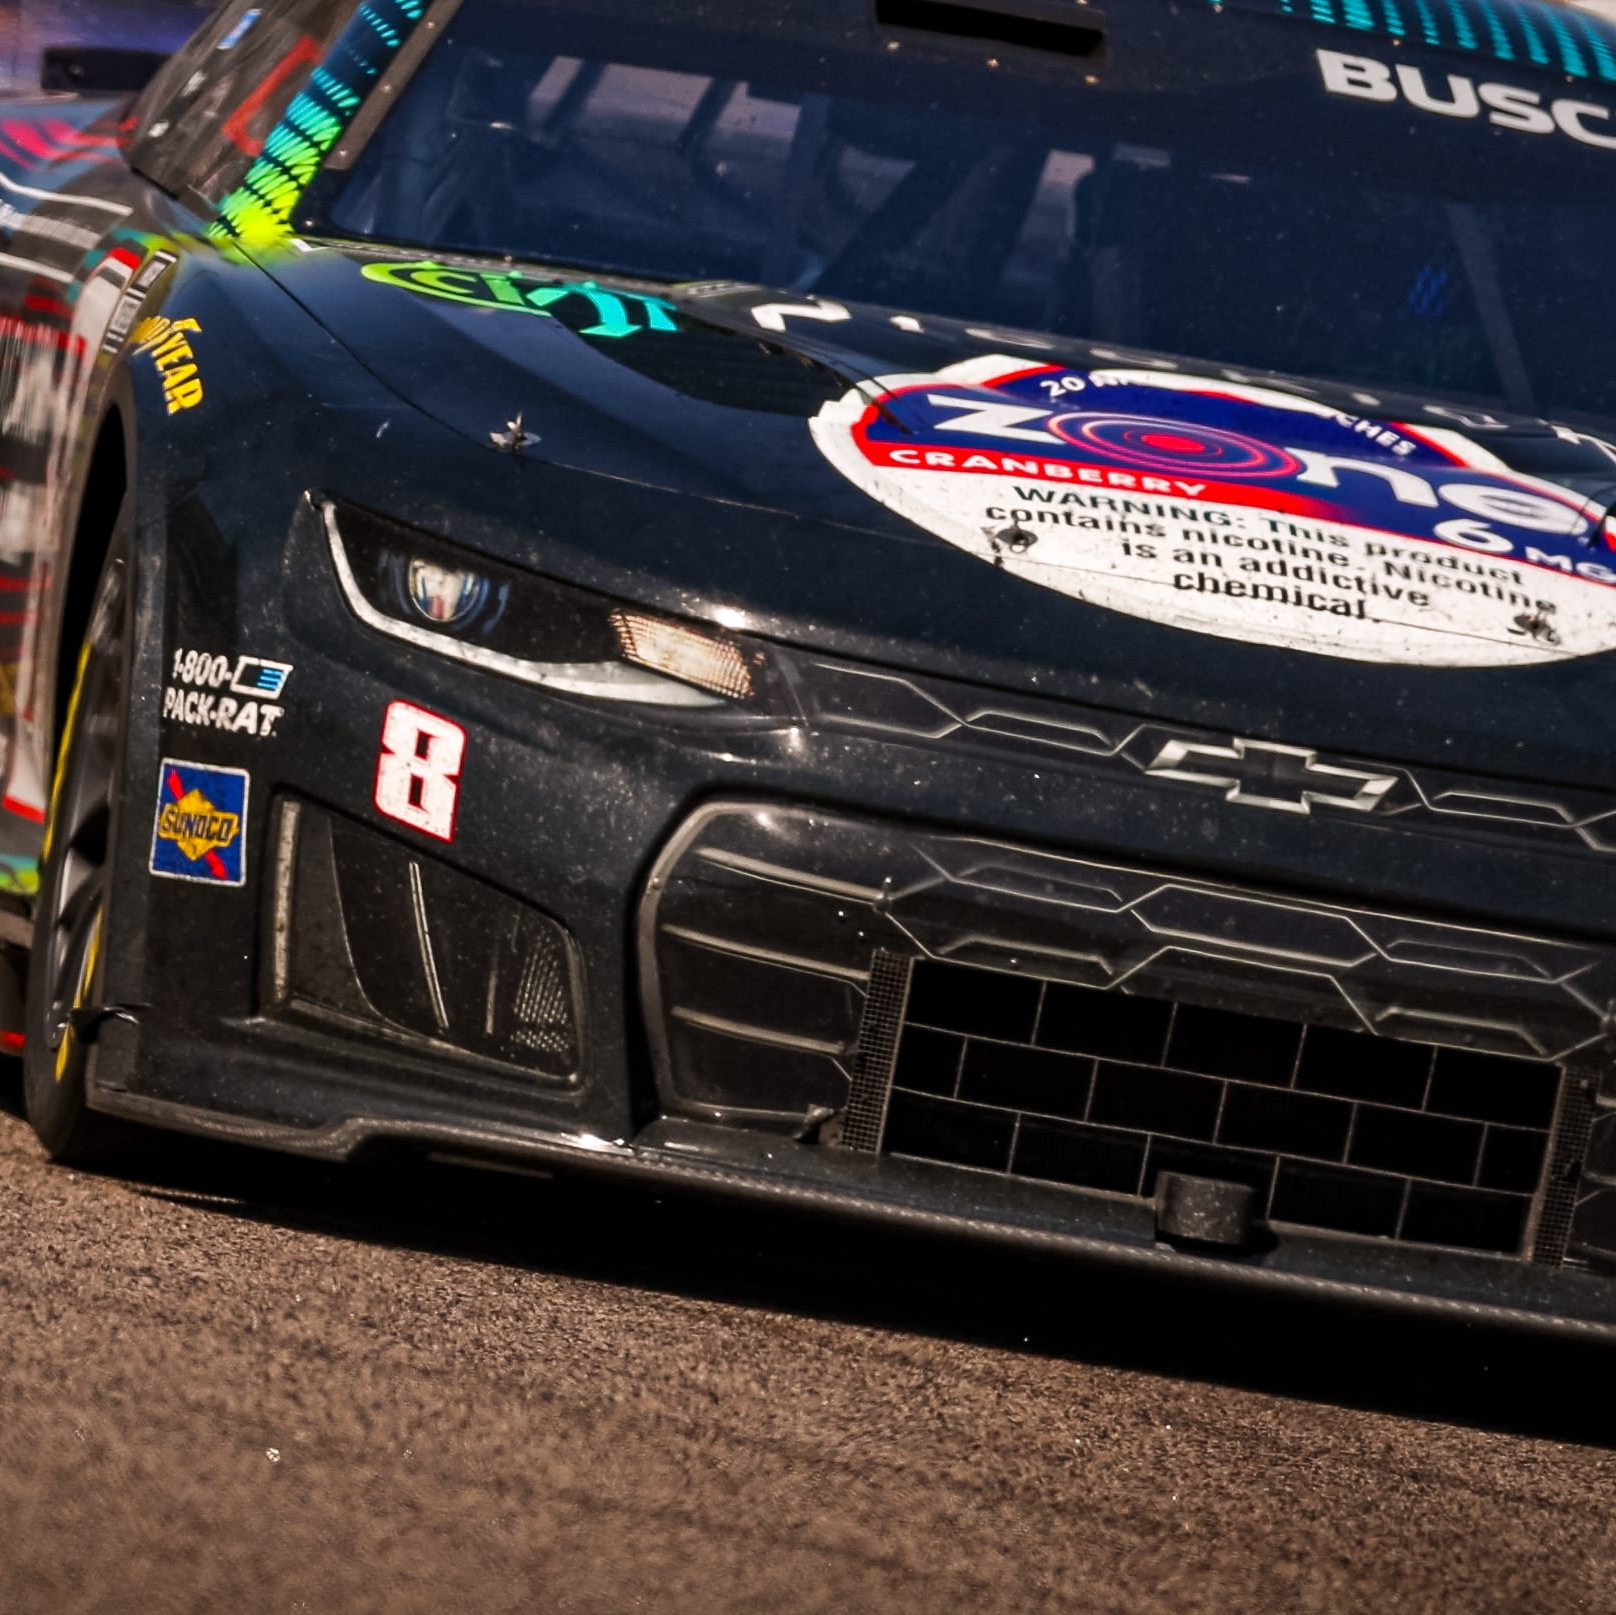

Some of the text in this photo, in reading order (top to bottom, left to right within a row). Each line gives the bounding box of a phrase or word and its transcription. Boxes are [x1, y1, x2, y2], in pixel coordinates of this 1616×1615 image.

[1040, 375, 1086, 397] 20
[888, 449, 1207, 497] CRANBERRY
[984, 506, 1558, 614] contains nicotine. Nicotine
[1012, 485, 1525, 587] WARNING: This product
[1432, 518, 1515, 555] 6
[1121, 539, 1431, 608] is an addictive
[1172, 572, 1385, 624] chemical.
[372, 699, 469, 843] 8
[161, 811, 236, 842] SUNOCO
